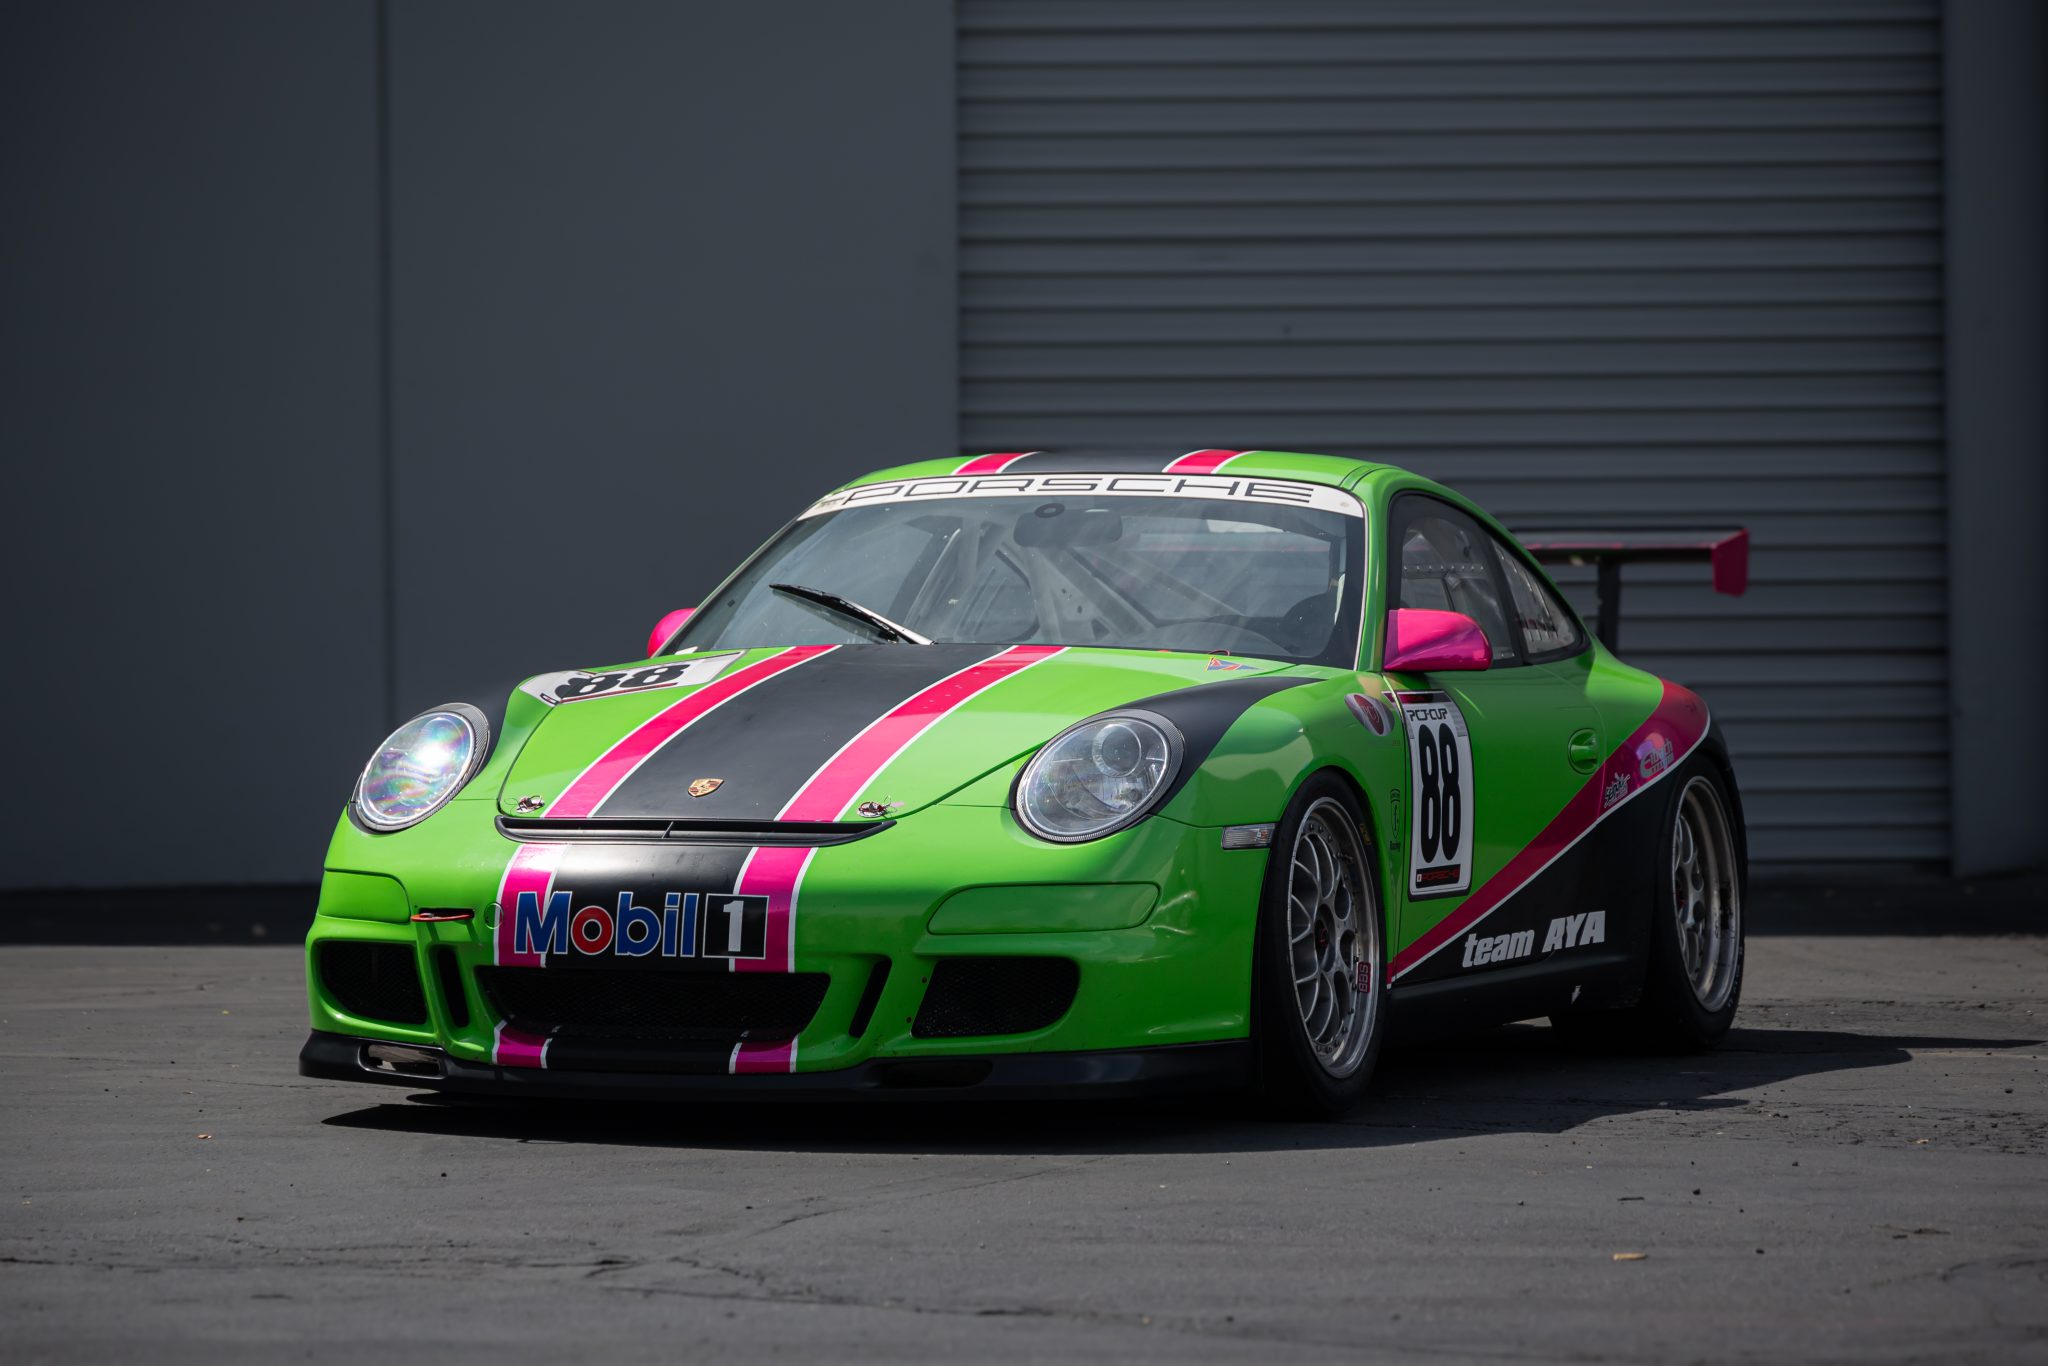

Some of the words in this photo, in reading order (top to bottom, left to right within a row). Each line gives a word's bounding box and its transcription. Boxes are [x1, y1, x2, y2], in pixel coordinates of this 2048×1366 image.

[843, 477, 1313, 505] PORSCHE
[555, 665, 690, 698] 88
[1418, 723, 1461, 863] 88
[513, 890, 699, 957] Mobil
[723, 899, 744, 952] 1
[1462, 928, 1534, 968] team
[1541, 910, 1606, 954] AYA
[1359, 963, 1368, 992] BBS
